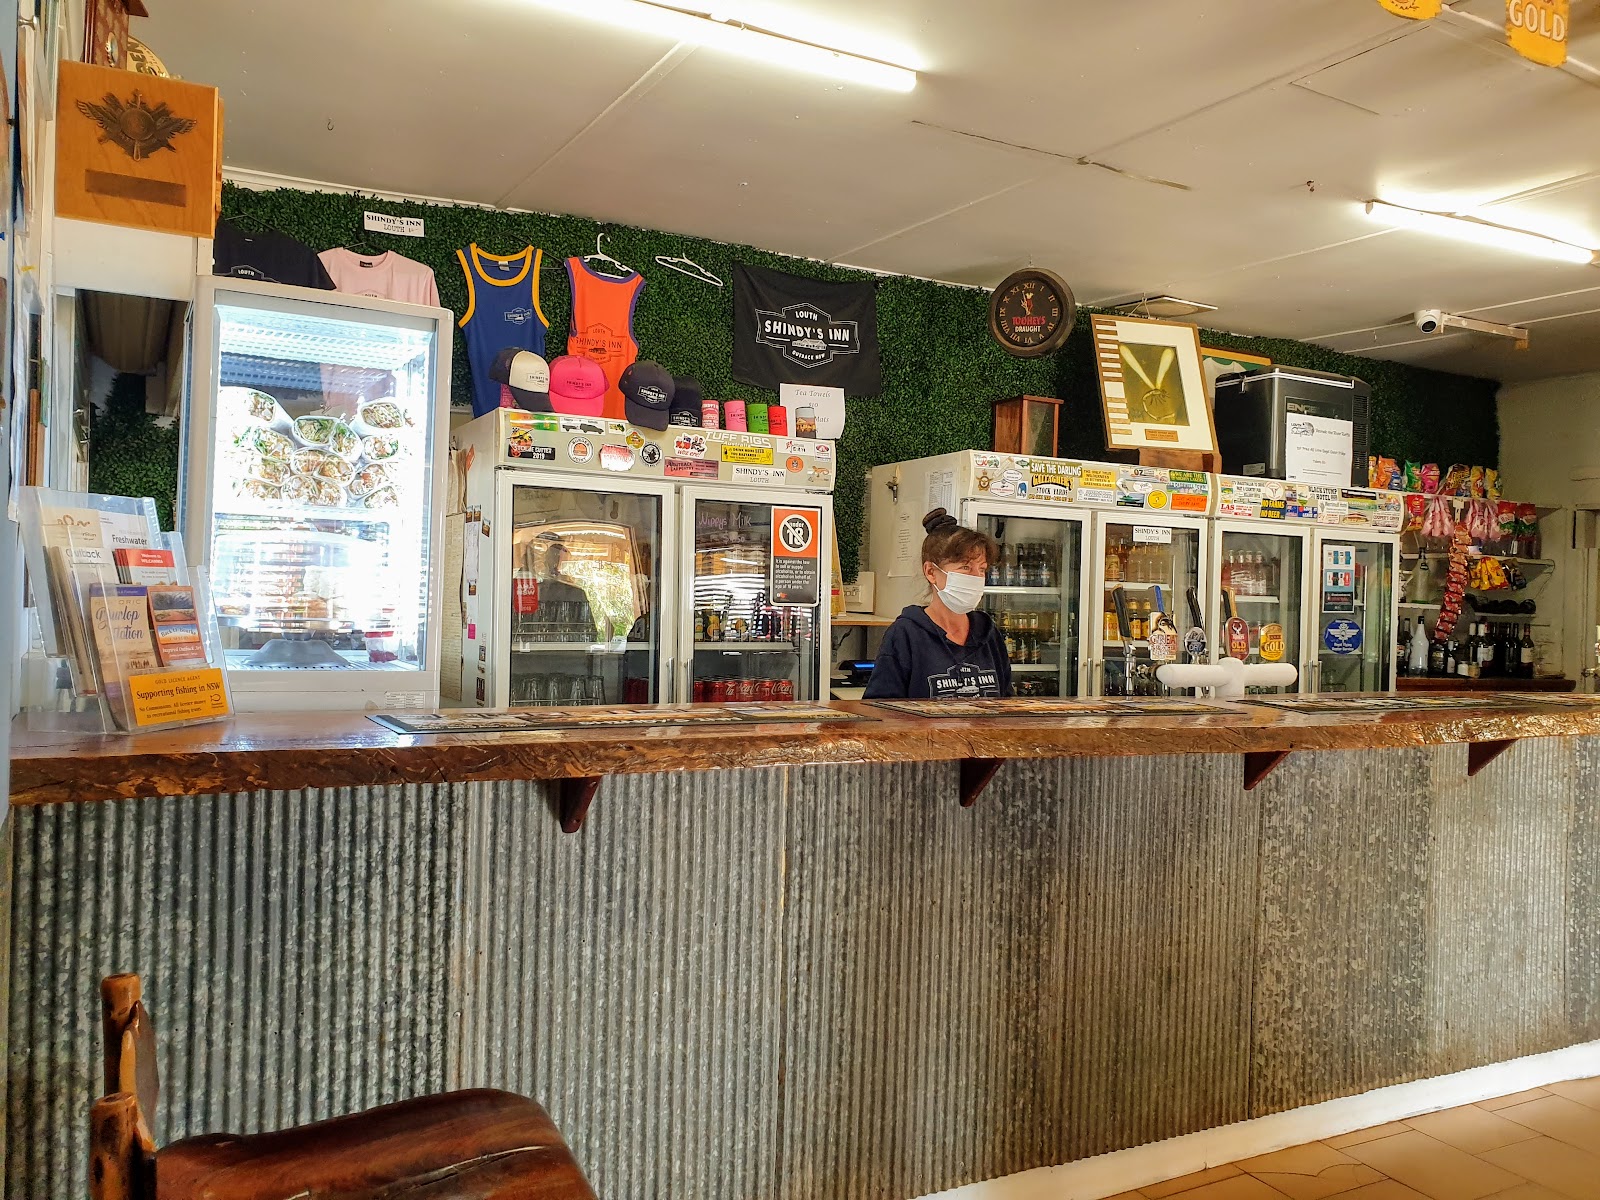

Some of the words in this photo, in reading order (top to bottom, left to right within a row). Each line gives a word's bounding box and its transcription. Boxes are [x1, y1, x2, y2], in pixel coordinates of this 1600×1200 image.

[1508, 0, 1566, 43] GOLD
[366, 214, 404, 226] SHINDY'S
[383, 224, 405, 233] LOUTH
[795, 311, 818, 322] LOUTH
[764, 319, 824, 340] SHINDY'S
[828, 328, 850, 342] INN
[1014, 325, 1042, 333] DRAUGHT
[576, 337, 608, 348] SHINDY'S
[608, 340, 623, 349] INN
[791, 350, 815, 361] OUTBACK
[795, 389, 807, 397] Tea
[808, 389, 832, 398] Towels
[705, 430, 738, 443] TUFF
[741, 434, 771, 448] RIGS
[533, 452, 546, 460] 2019
[534, 446, 553, 455] CUTTER
[735, 467, 769, 477] SHINDY'S
[772, 468, 785, 477] INN
[1031, 462, 1045, 474] SAVE
[1045, 463, 1057, 475] THE
[1057, 465, 1082, 477] DARLING
[749, 476, 770, 484] LOUTH
[1220, 503, 1235, 511] LAS
[1262, 499, 1269, 509] NO
[1269, 500, 1286, 509] FARMS
[1260, 510, 1268, 518] NO
[1268, 510, 1281, 519] BEER
[698, 511, 728, 530] Nippys
[732, 511, 752, 529] Milk
[786, 526, 804, 547] 18
[1134, 527, 1160, 535] SHINDY'S
[111, 534, 148, 547] Freshwater
[96, 605, 141, 627] Dunlop
[1231, 641, 1247, 650] OLD
[1263, 641, 1286, 653] GOLD
[977, 674, 996, 685] INN
[136, 688, 175, 701] Supporting
[175, 684, 198, 695] fishing
[198, 684, 206, 692] in
[206, 682, 221, 691] NSW
[152, 710, 177, 719] recreational
